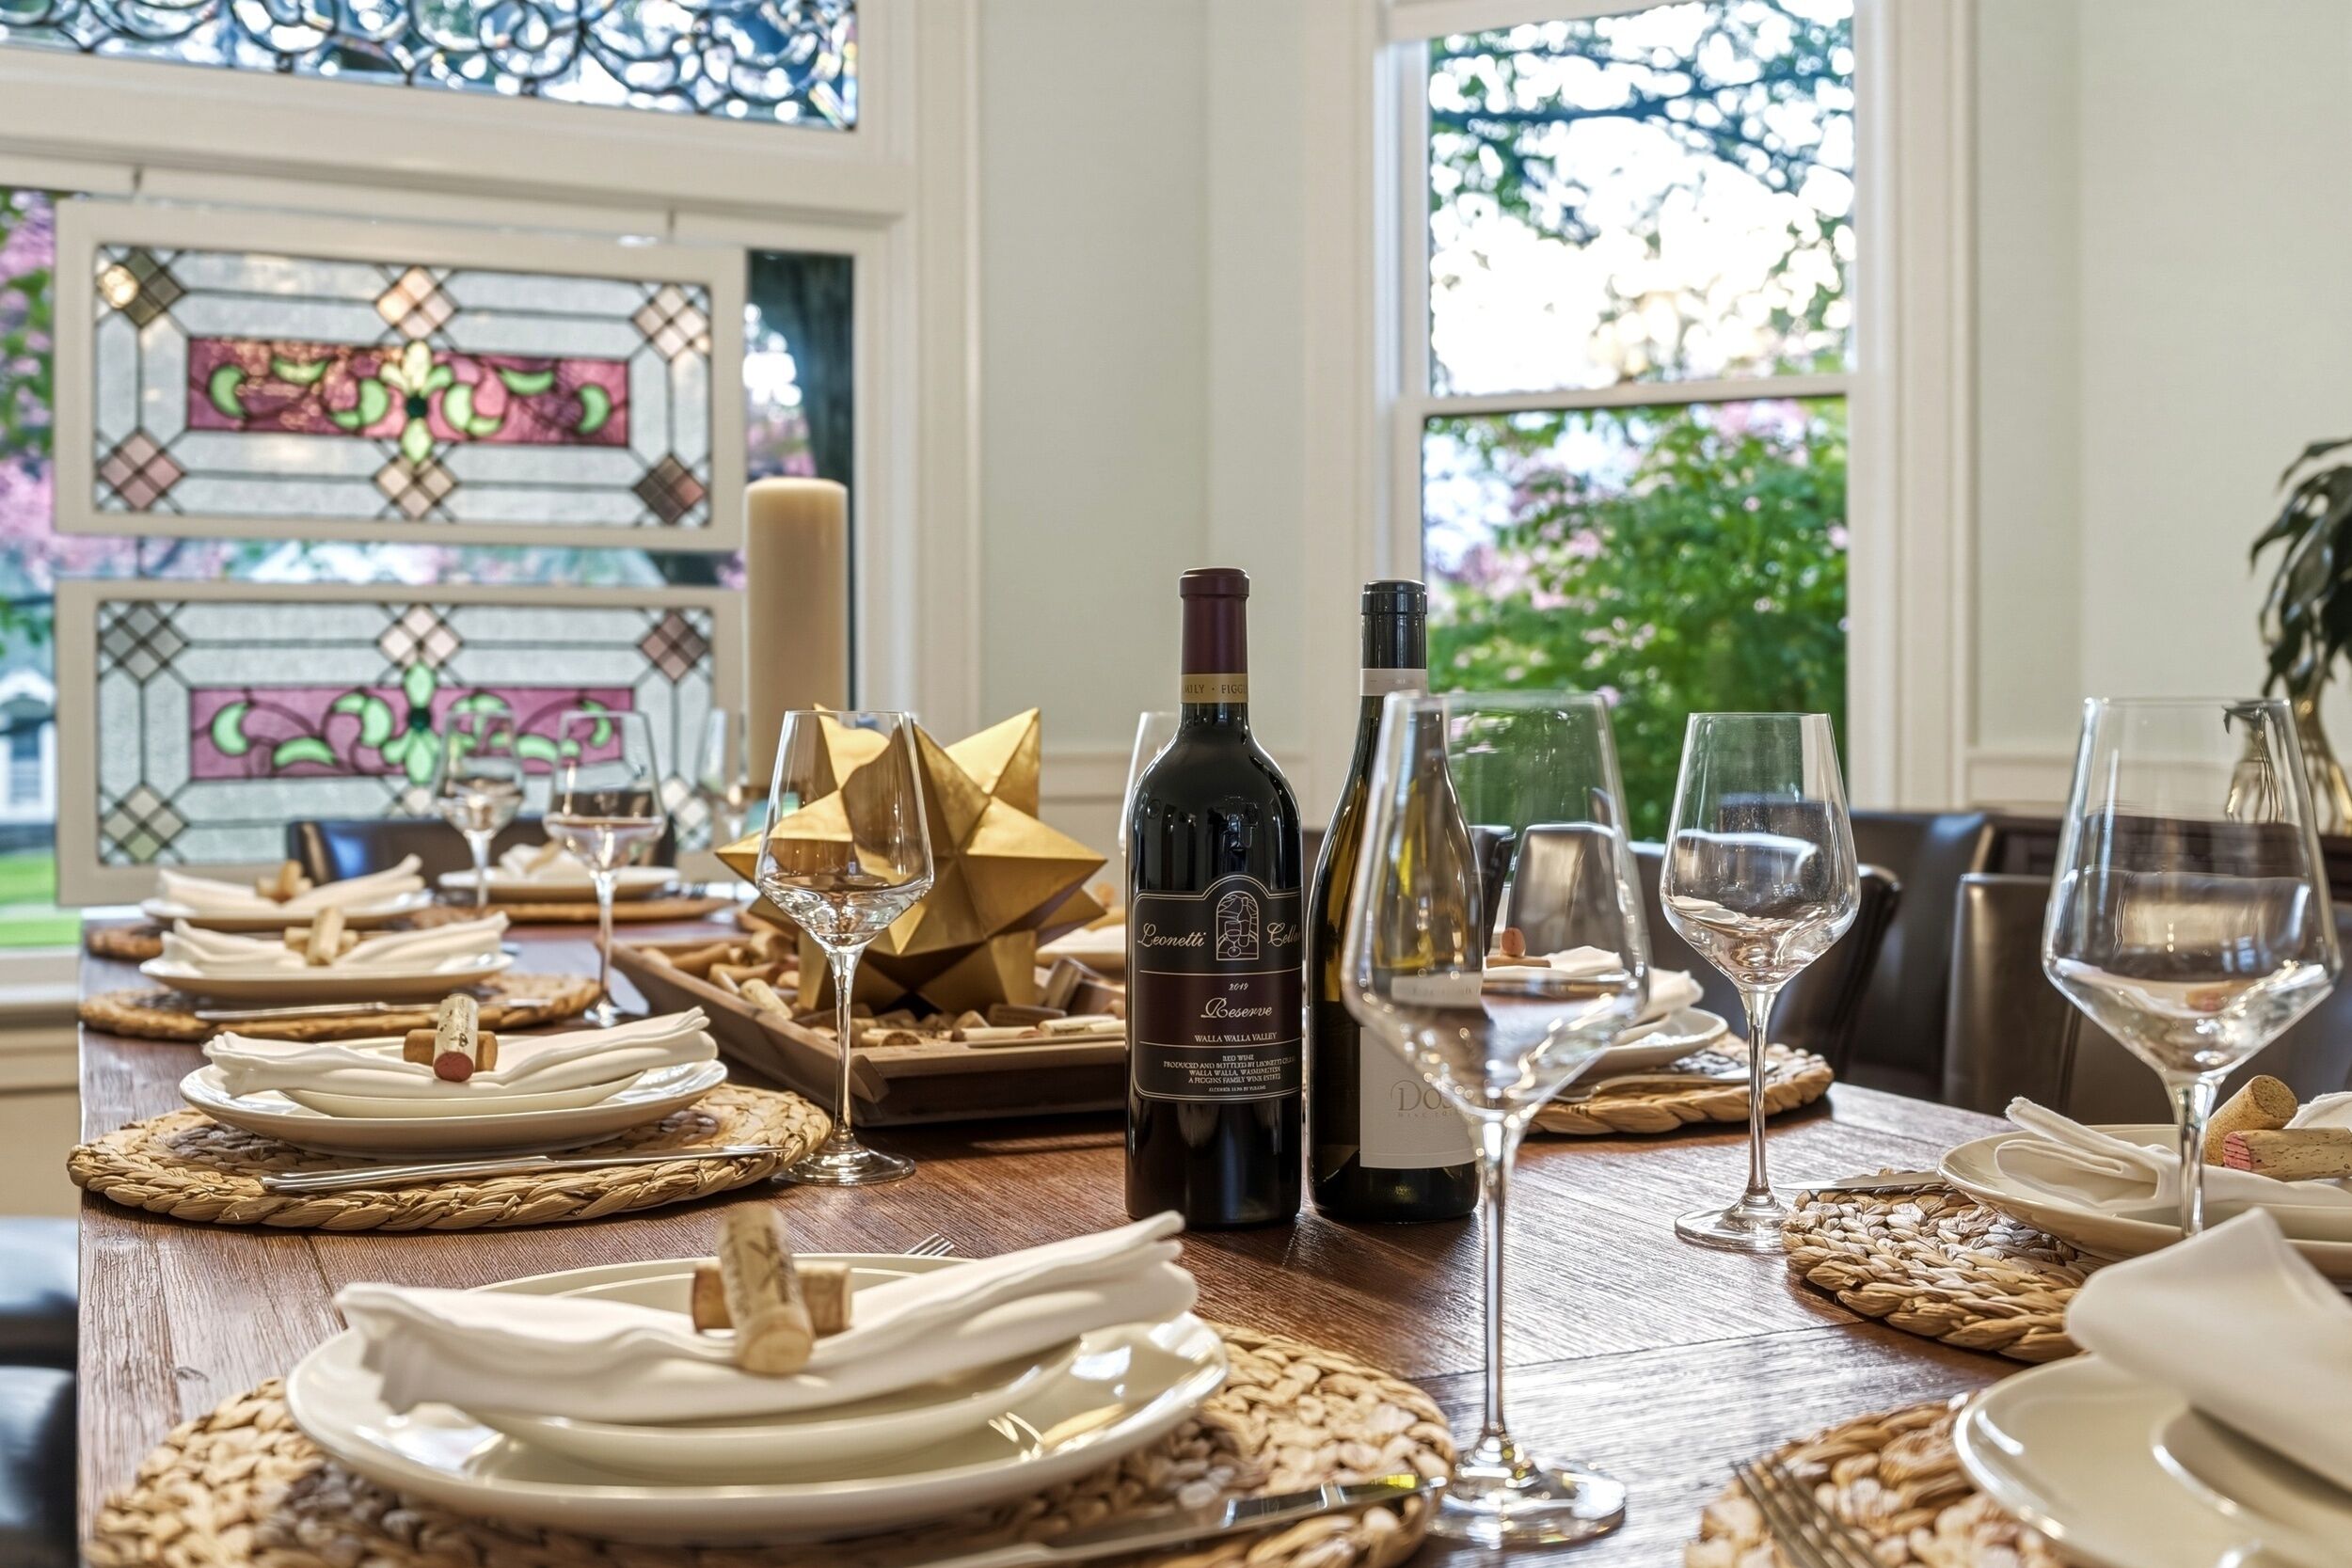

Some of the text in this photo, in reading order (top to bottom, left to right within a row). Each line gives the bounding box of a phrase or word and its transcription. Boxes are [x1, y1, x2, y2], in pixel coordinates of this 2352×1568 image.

[1137, 922, 1207, 948] Leonetti
[1200, 997, 1273, 1019] Reserve
[1194, 1031, 1278, 1043] WALLA WALLA VALLEY
